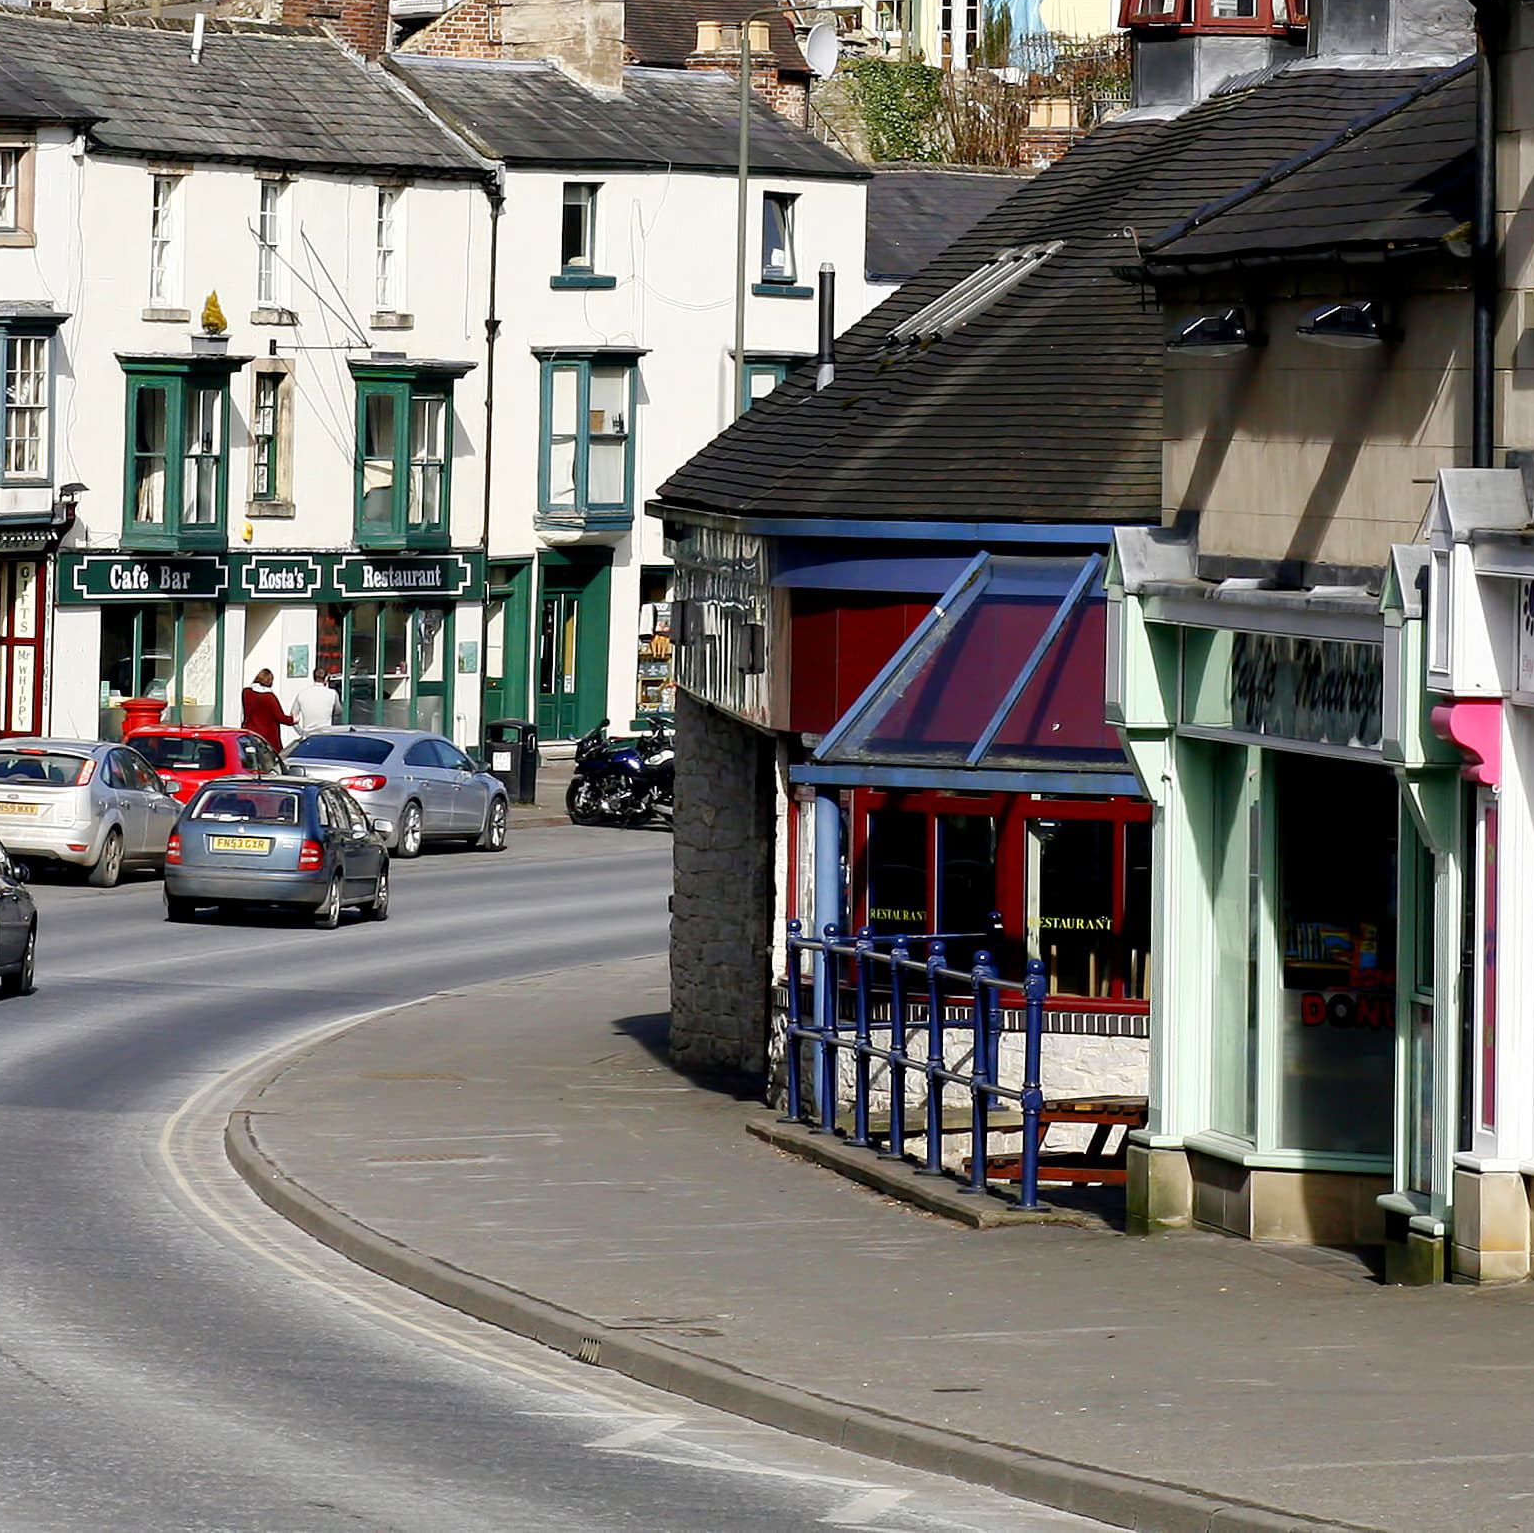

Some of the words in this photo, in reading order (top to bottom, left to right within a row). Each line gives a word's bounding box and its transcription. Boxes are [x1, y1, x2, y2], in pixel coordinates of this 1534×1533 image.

[109, 562, 149, 590] Café
[159, 566, 191, 591] Bar
[258, 566, 305, 591] Kosta's
[362, 564, 442, 589] Restaurant
[20, 567, 31, 634] GIFTS
[18, 649, 30, 660] Mr
[18, 666, 28, 726] WHIPPY
[869, 908, 927, 922] RESTAURANT
